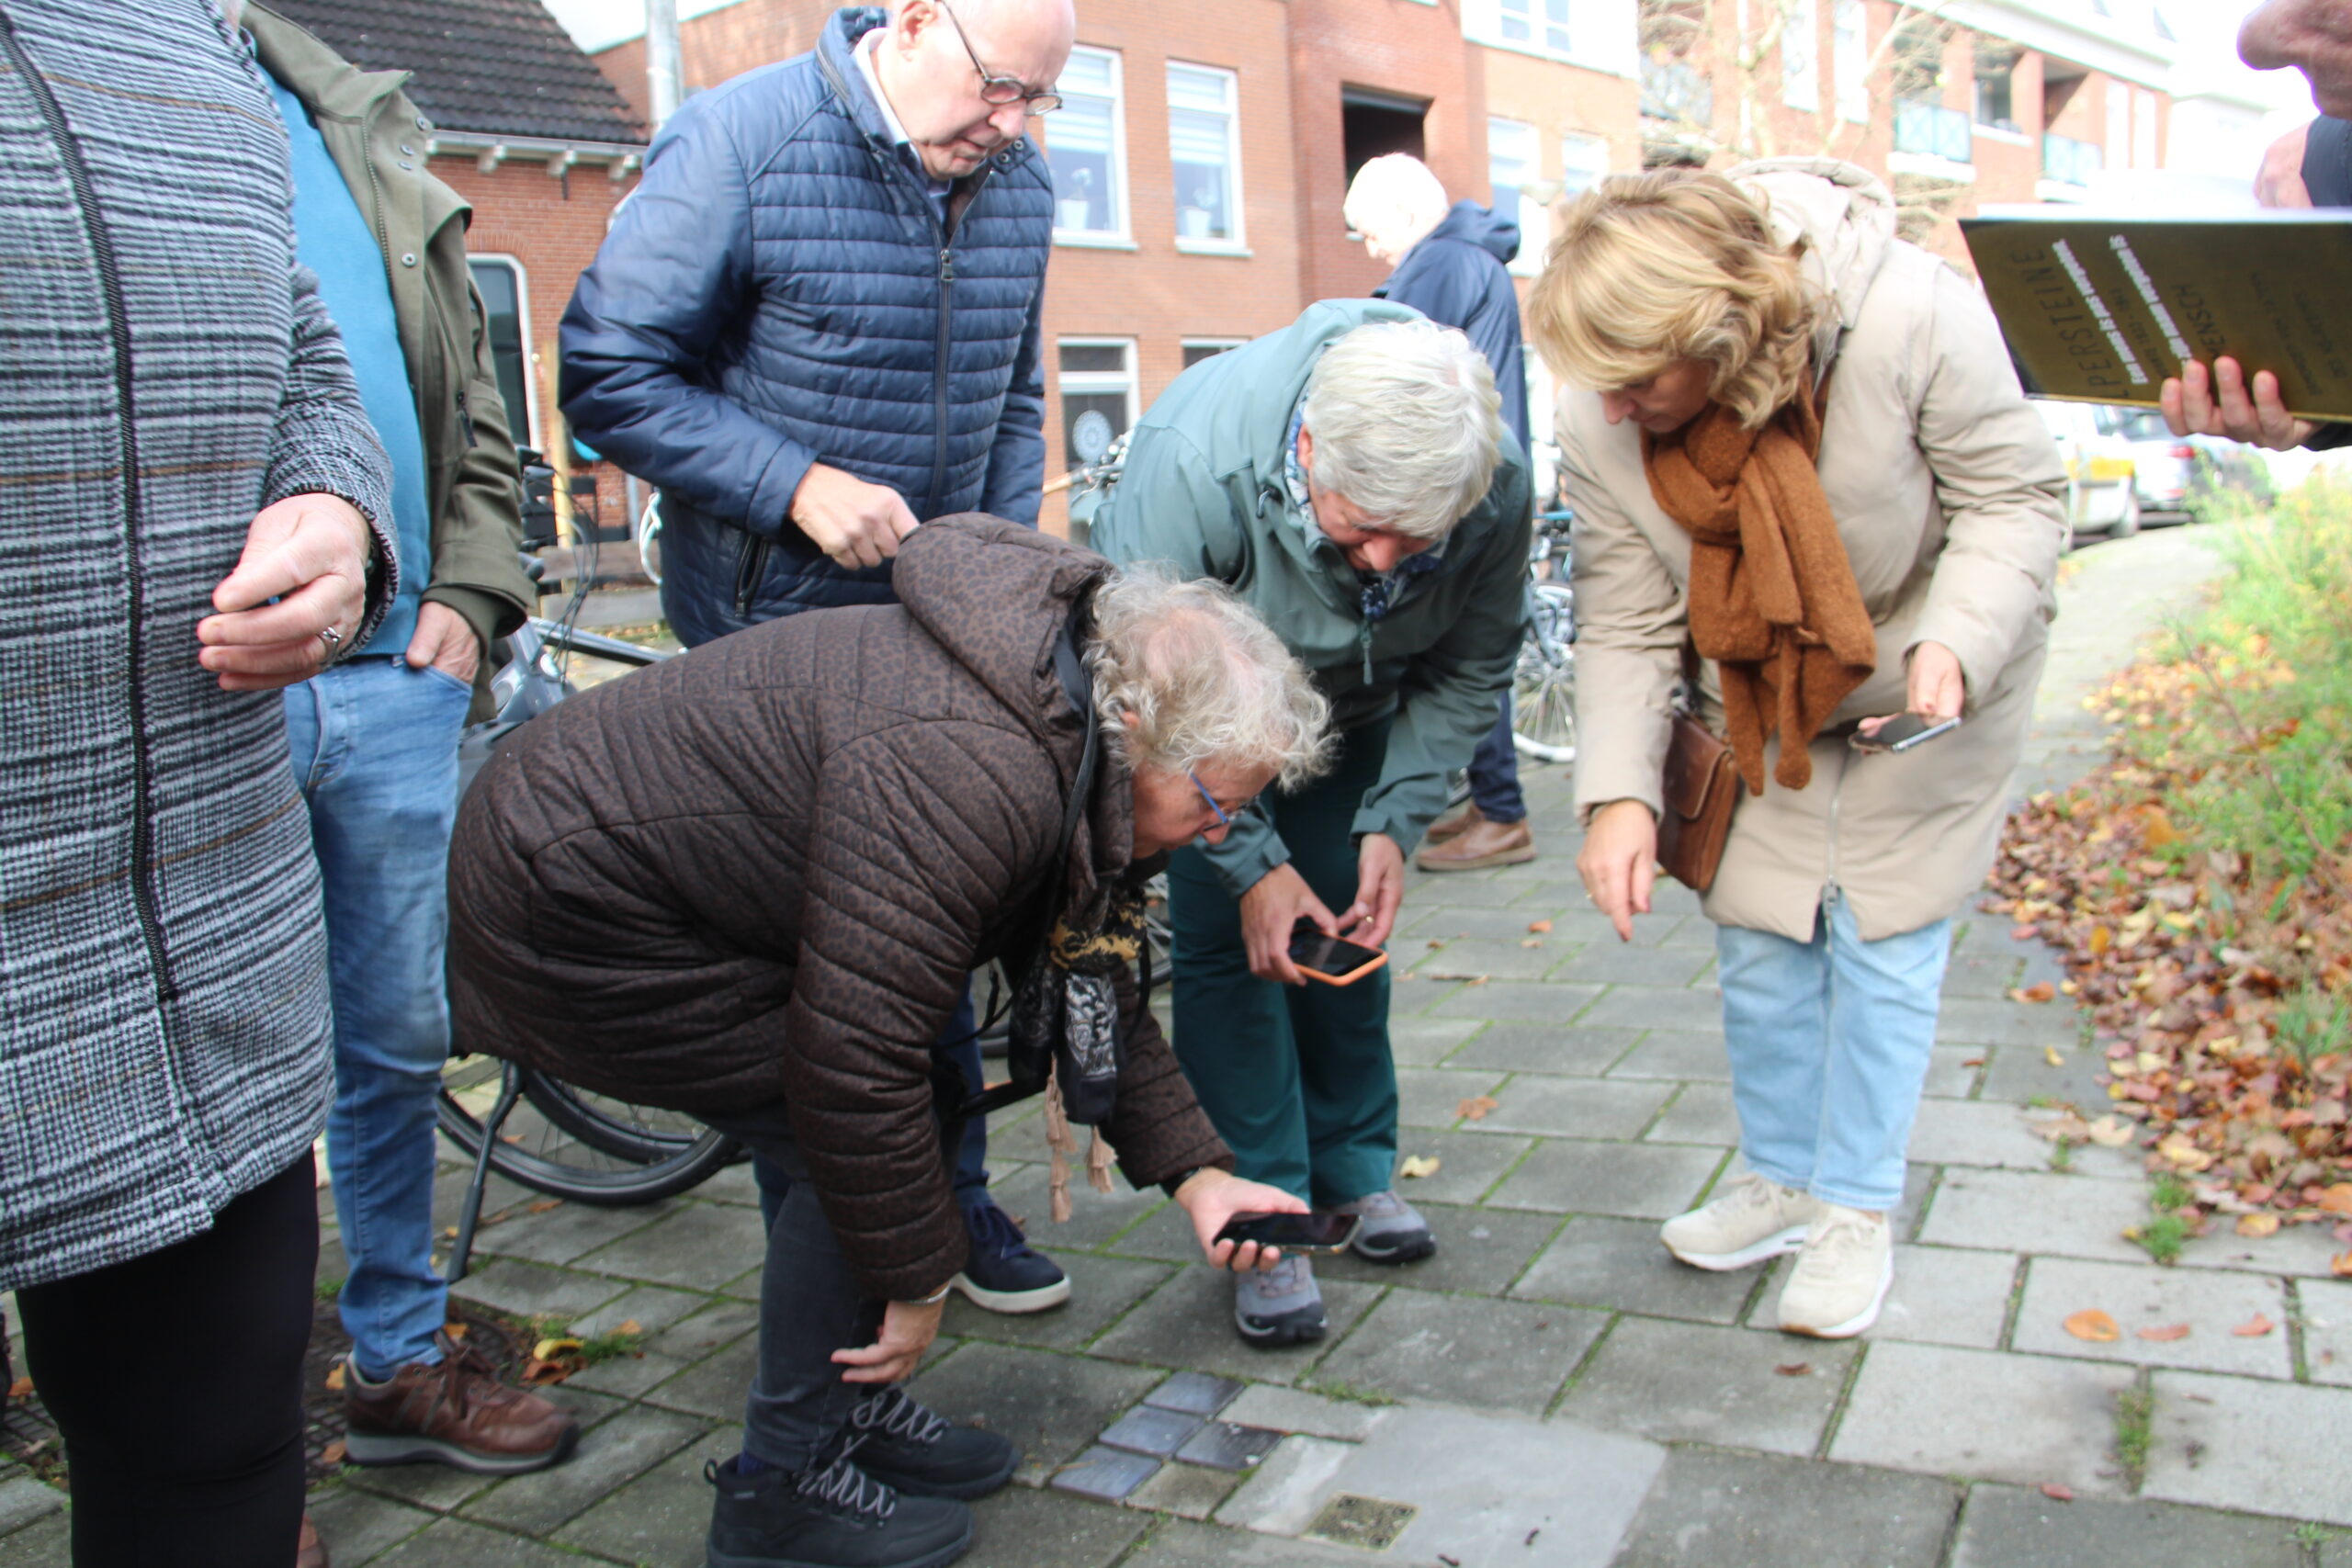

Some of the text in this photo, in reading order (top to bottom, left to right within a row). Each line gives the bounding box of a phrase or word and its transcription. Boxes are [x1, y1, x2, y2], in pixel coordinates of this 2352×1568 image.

[2109, 234, 2129, 250] is
[2098, 318, 2117, 332] is
[2126, 363, 2149, 384] Een
